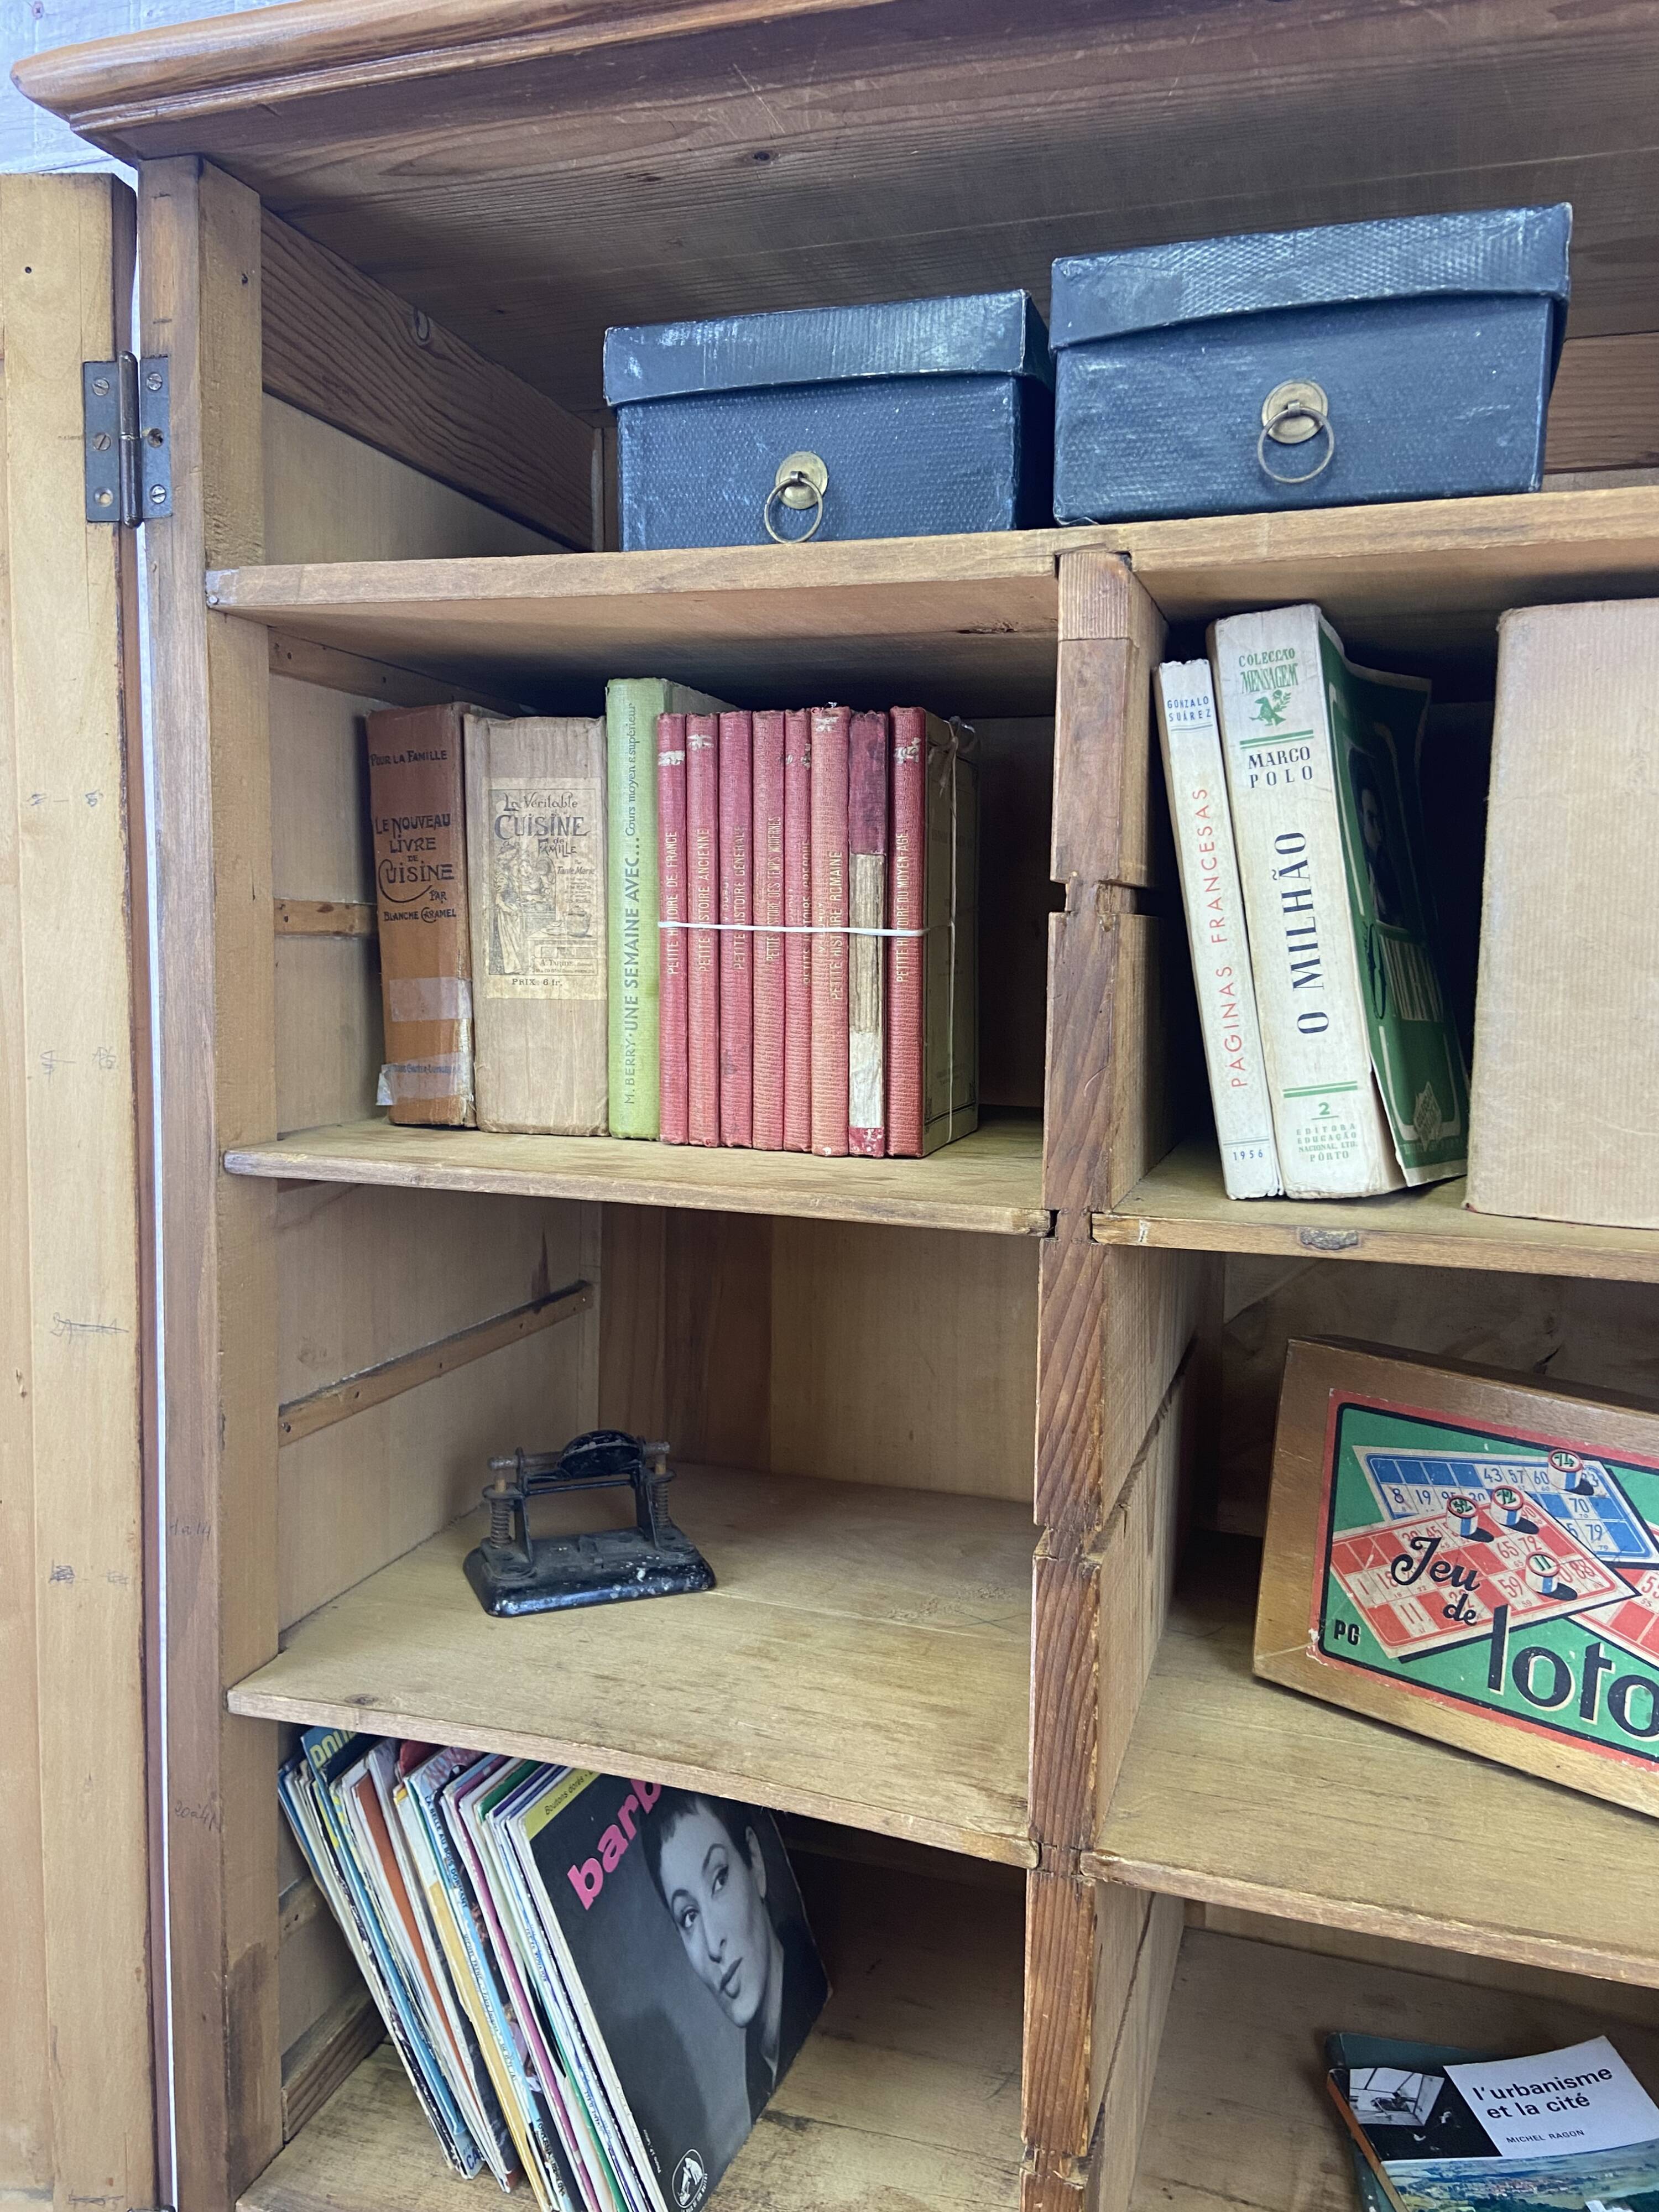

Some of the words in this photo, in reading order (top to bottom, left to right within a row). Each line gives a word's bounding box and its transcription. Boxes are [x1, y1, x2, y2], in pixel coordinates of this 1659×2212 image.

[1240, 662, 1299, 693] MENSAGEM
[1167, 695, 1209, 709] GONZALO
[1169, 708, 1212, 722] SUÁREZ
[370, 754, 391, 766] POUR
[393, 754, 405, 764] LA
[407, 750, 447, 763] FAMILLE
[1248, 746, 1311, 769] MARCO
[628, 765, 639, 802] moyen
[1250, 765, 1313, 789] POLO
[504, 792, 522, 811] La
[524, 791, 578, 808] Véritable
[375, 816, 389, 834] LE
[392, 813, 451, 838] NOUVEAU
[494, 813, 591, 840] CUISINE
[625, 806, 637, 836] Cours
[390, 834, 436, 853] LIVRE
[665, 831, 677, 868] FRANCE
[696, 829, 710, 880] ANCIENNE
[767, 857, 781, 879] TEMPS
[830, 852, 842, 901] ROMAINE
[1192, 789, 1228, 943] FRANCESAS
[378, 859, 455, 903] CUISINE
[666, 874, 678, 887] DE
[768, 882, 781, 898] DES
[429, 890, 447, 901] PAR
[896, 890, 909, 903] DU
[384, 911, 419, 922] BLANCHE
[666, 894, 679, 936] HITOIRE
[766, 901, 780, 931] STOIRE
[1271, 832, 1324, 991] MILHÃO
[830, 907, 843, 957] HISTIRE
[896, 906, 909, 946] HITOIRE
[624, 907, 640, 989] SEMAINE
[667, 941, 679, 974] PETITE
[698, 937, 711, 972] PETITE
[733, 933, 746, 969] PETITE
[766, 936, 779, 961] PETITE
[896, 950, 909, 982] PETITE
[830, 962, 843, 1000] PETITE
[624, 995, 639, 1031] UNE
[1297, 1011, 1329, 1034] O
[625, 1039, 636, 1086] BERRY
[624, 1089, 635, 1105] M.
[1318, 1102, 1331, 1116] 2
[1296, 1123, 1356, 1136] EDITORA
[1233, 1149, 1264, 1161] 1956
[1484, 1468, 1504, 1484] 43
[1507, 1469, 1525, 1483] 57
[1533, 1471, 1549, 1485] 60
[1391, 1488, 1405, 1504] 8
[1415, 1489, 1432, 1506] 19
[1569, 1498, 1589, 1514] 70
[1517, 1535, 1542, 1552] 72
[1585, 1524, 1603, 1542] 79
[1496, 1541, 1520, 1559] 65
[1390, 1536, 1481, 1591] Jeu
[1498, 1576, 1524, 1598] 59
[1442, 1593, 1478, 1626] de
[1333, 1619, 1361, 1646] PG
[1488, 1603, 1659, 1740] loto
[428, 1808, 442, 1833] BELLE
[1472, 2066, 1613, 2102] l'urbanisme
[1486, 2104, 1511, 2120] et
[1519, 2101, 1540, 2117] la
[1546, 2091, 1591, 2112] cité
[1505, 2133, 1546, 2145] MICHEL
[1548, 2128, 1585, 2141] RAGON
